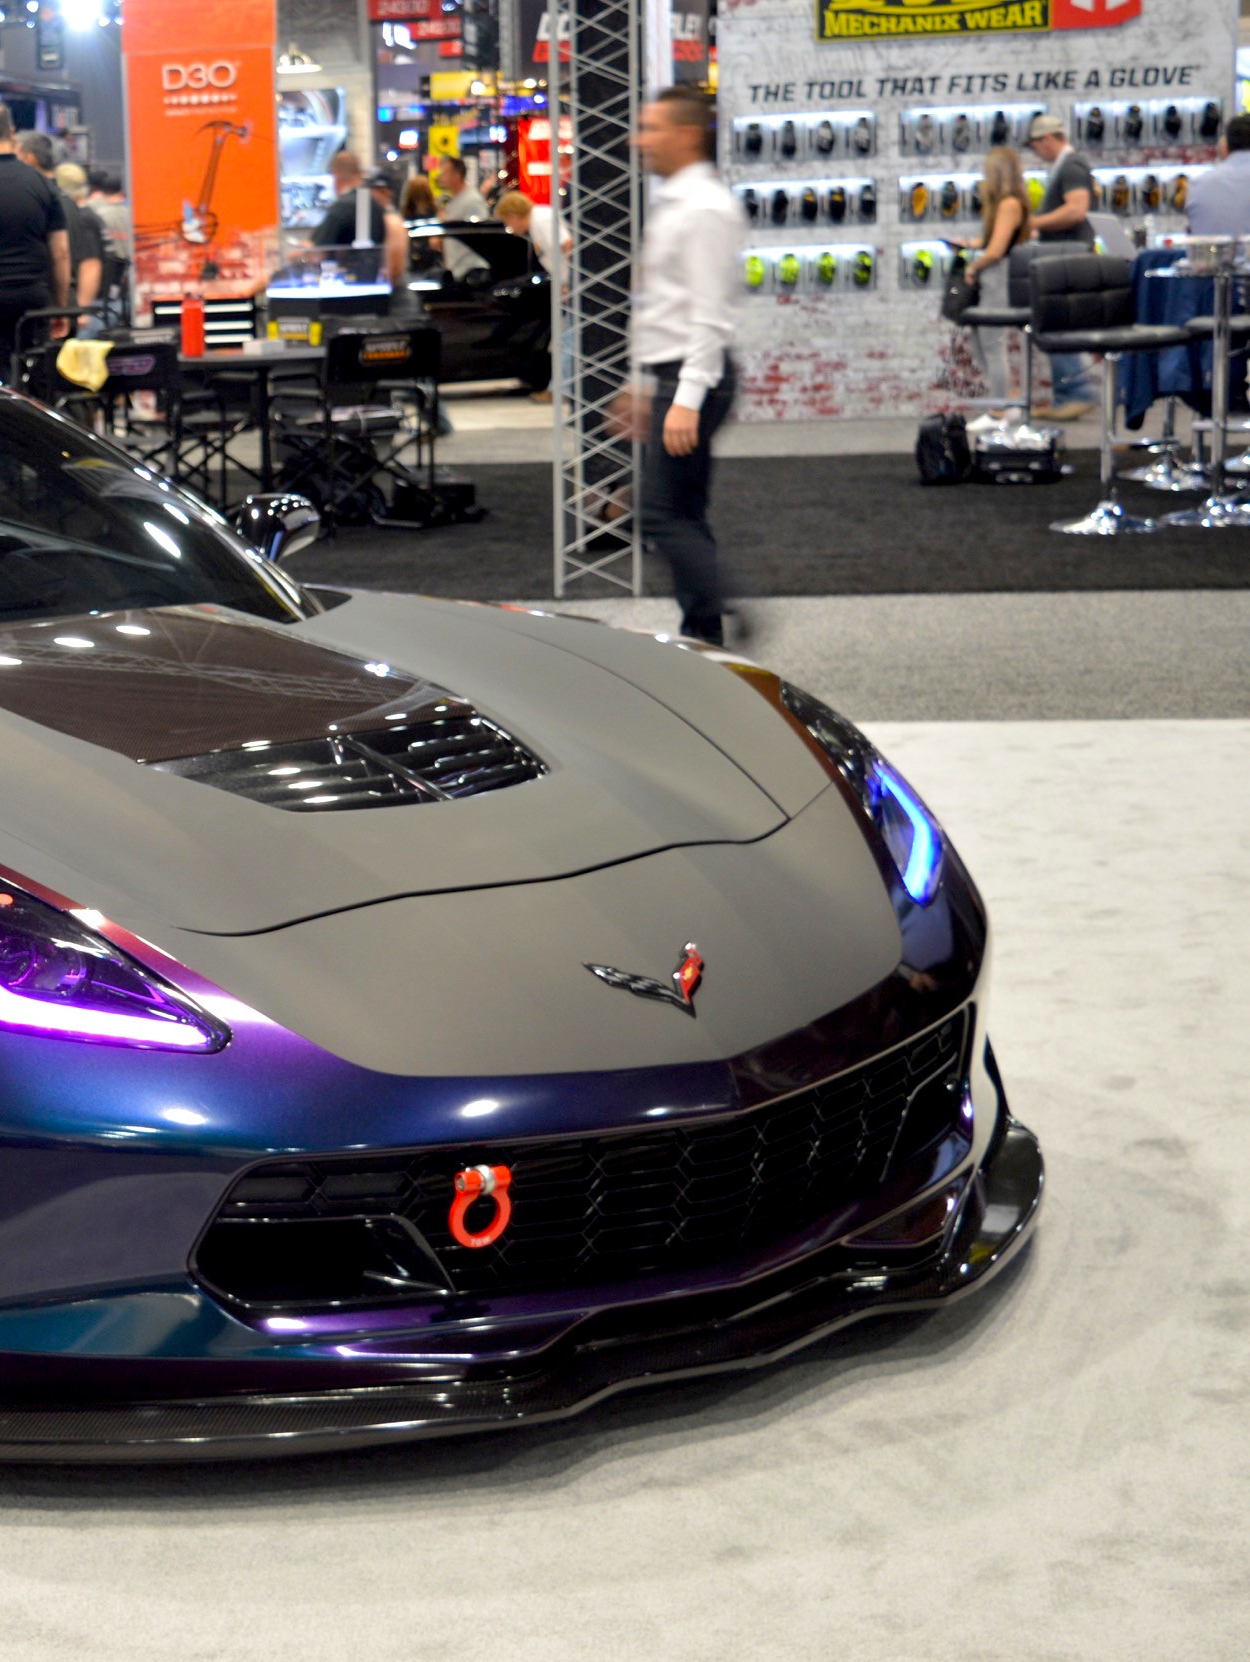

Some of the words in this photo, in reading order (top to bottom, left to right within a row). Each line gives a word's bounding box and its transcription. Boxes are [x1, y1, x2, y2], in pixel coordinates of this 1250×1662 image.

[824, 10, 961, 37] MECHANIX
[964, 1, 1044, 30] WEAR
[749, 83, 796, 103] THE
[804, 80, 866, 100] TOOL
[875, 76, 941, 97] THAT
[948, 73, 1008, 94] FITS
[1016, 70, 1078, 91] LIKE
[1083, 69, 1100, 89] A
[1109, 65, 1194, 88] GLOVE
